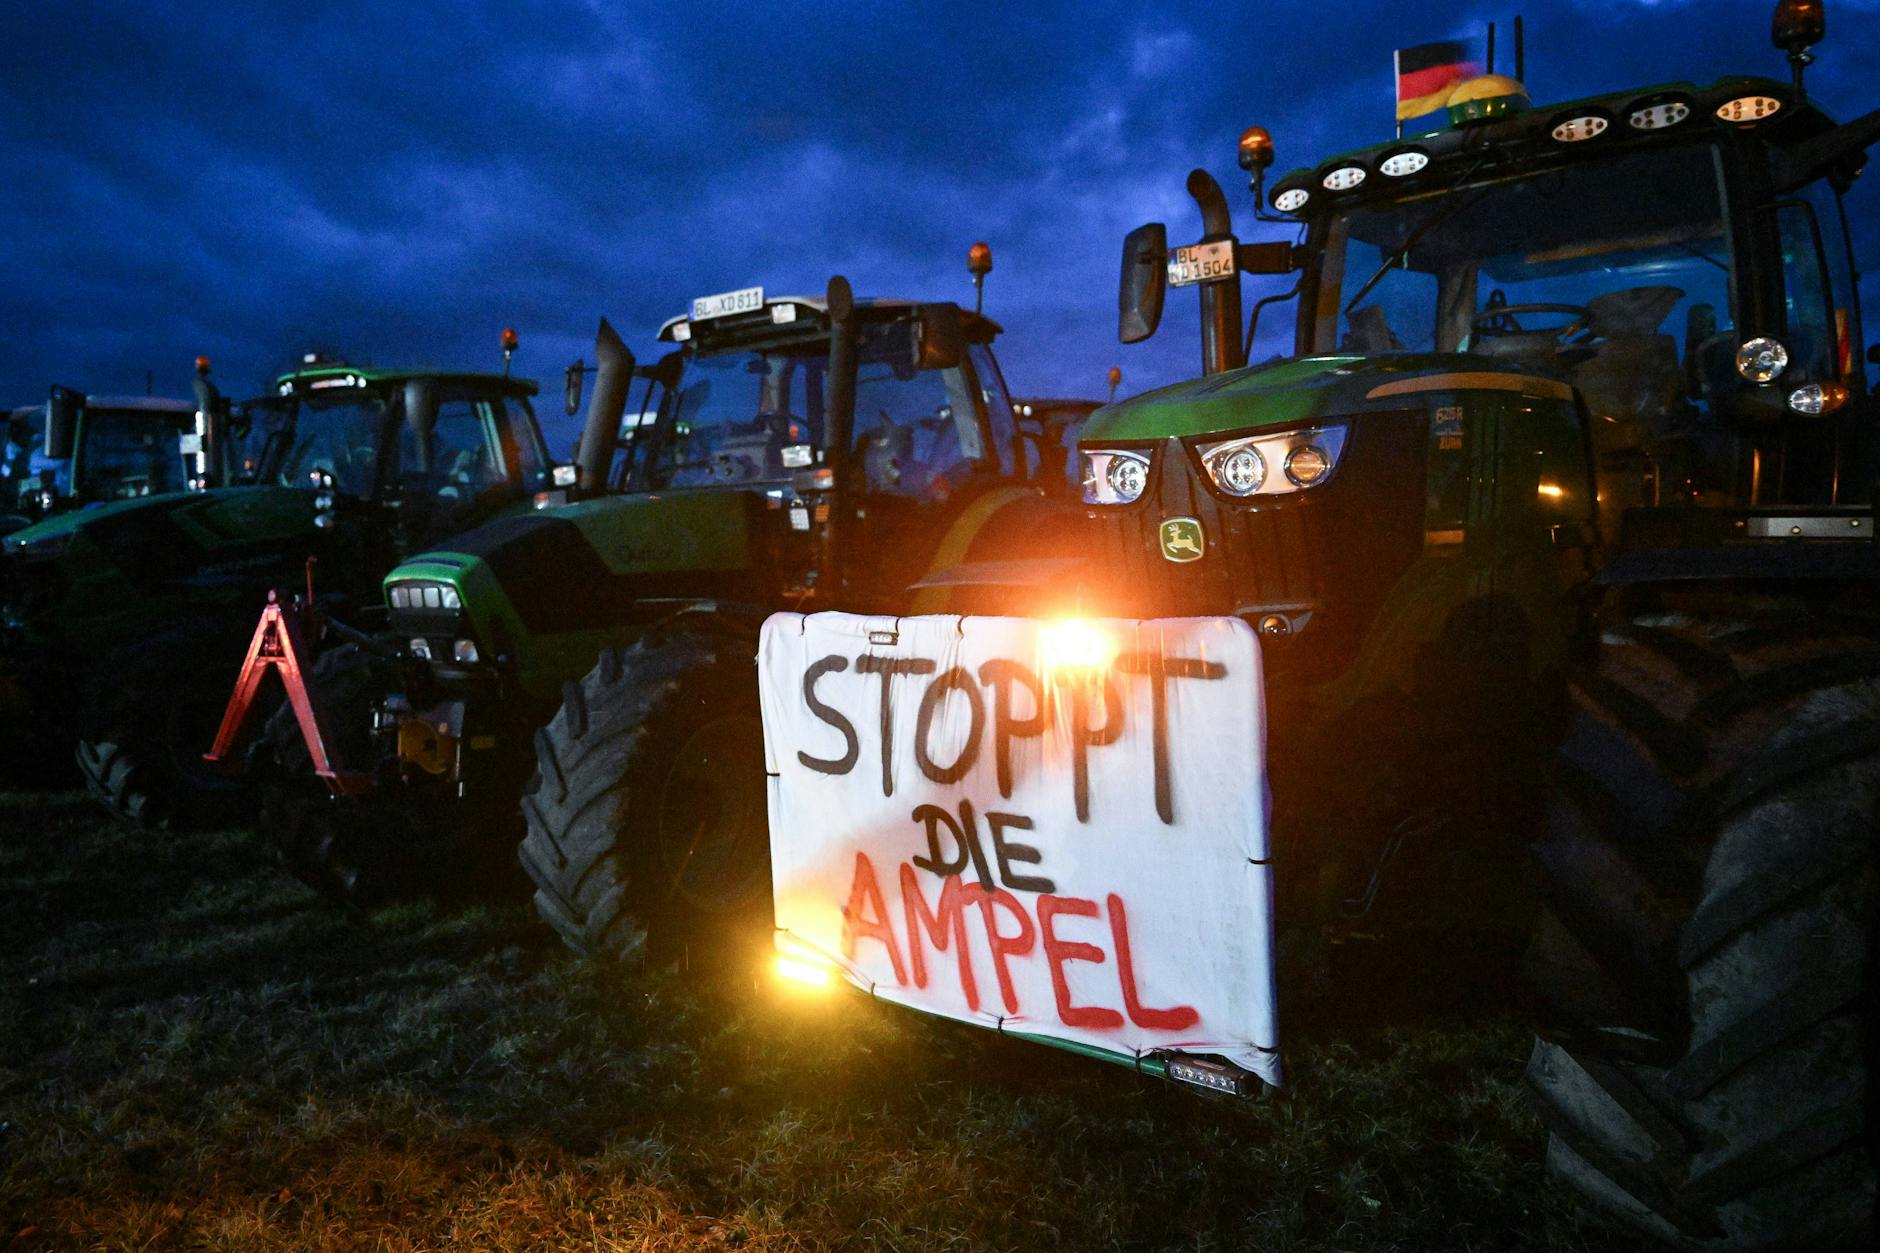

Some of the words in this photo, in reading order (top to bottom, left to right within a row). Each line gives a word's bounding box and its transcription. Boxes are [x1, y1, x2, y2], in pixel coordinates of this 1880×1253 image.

[1178, 249, 1198, 264] BL
[695, 301, 712, 317] BL
[797, 654, 1228, 826] STOPPT
[911, 799, 1057, 895] DIE
[841, 851, 1200, 1032] AMPEL
